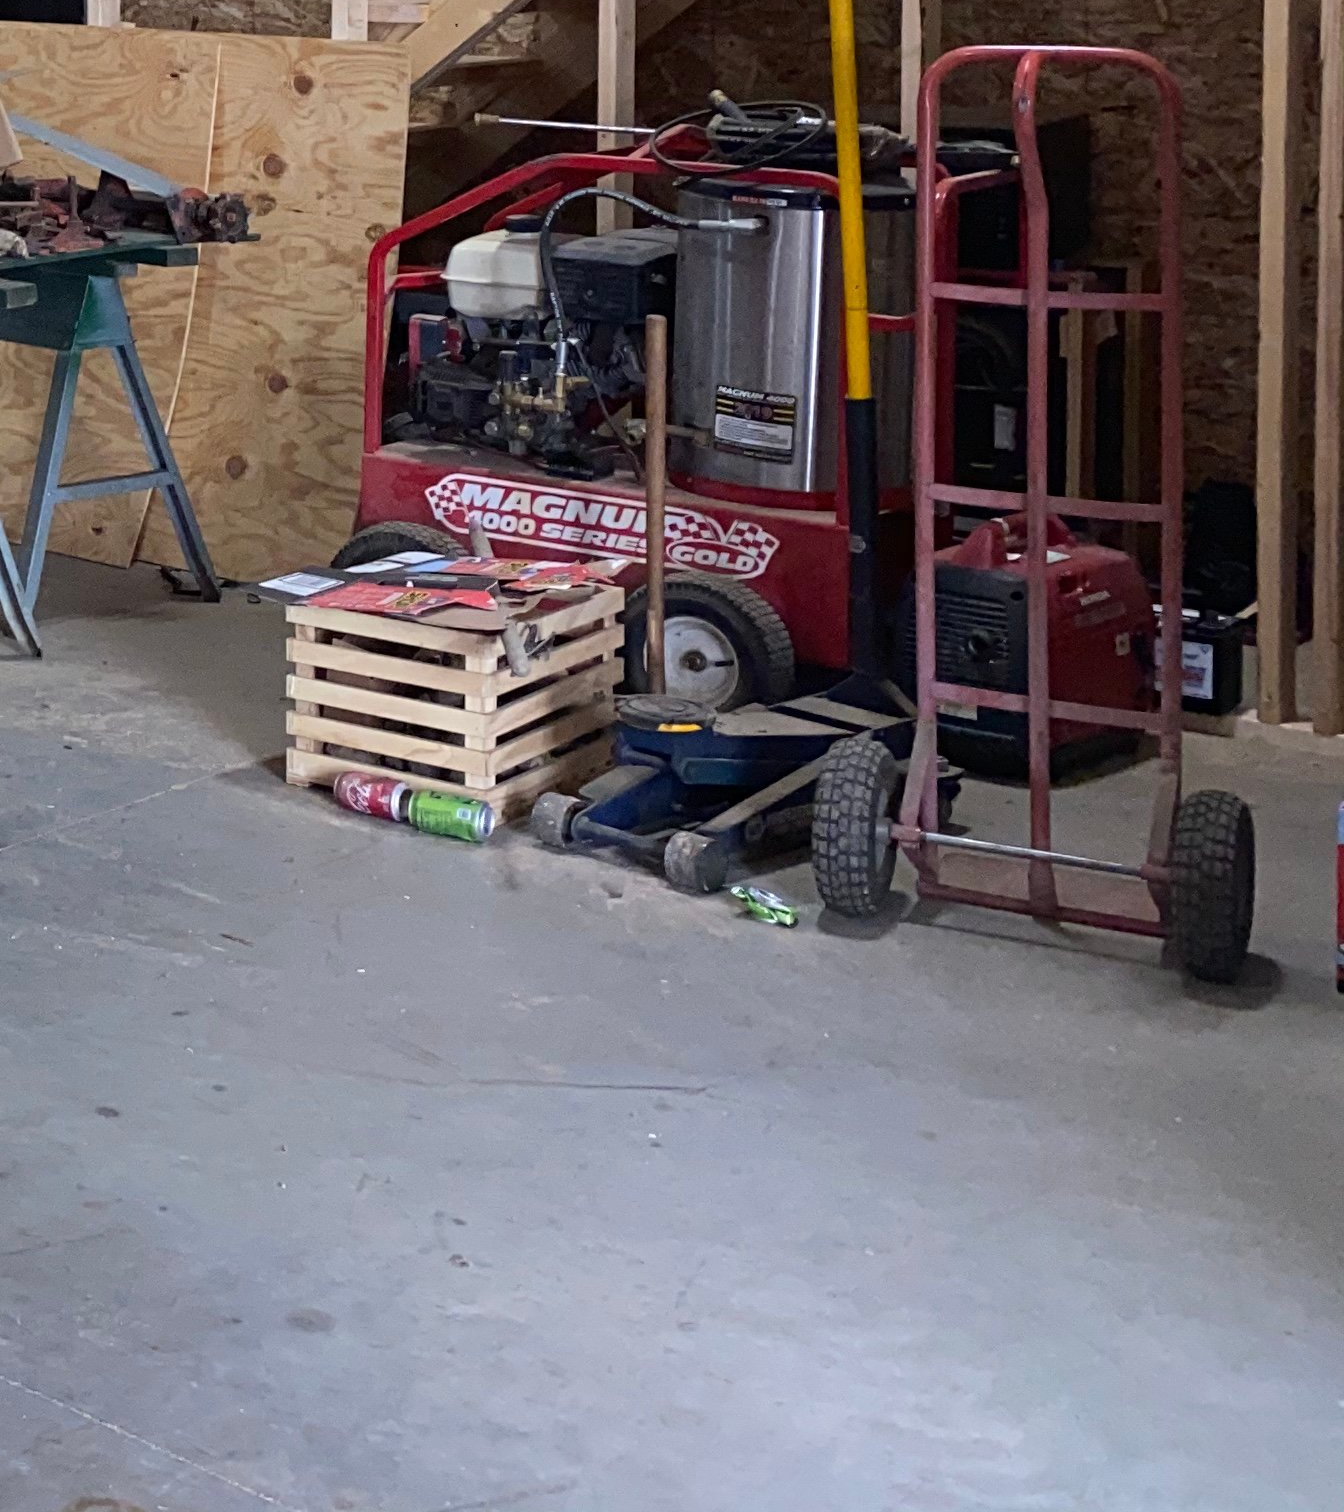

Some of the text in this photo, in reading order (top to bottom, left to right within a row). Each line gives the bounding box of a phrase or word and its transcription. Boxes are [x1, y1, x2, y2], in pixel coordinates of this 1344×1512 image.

[717, 385, 764, 400] MAGNUM
[461, 483, 647, 534] MAGNU
[672, 545, 755, 571] GOLD
